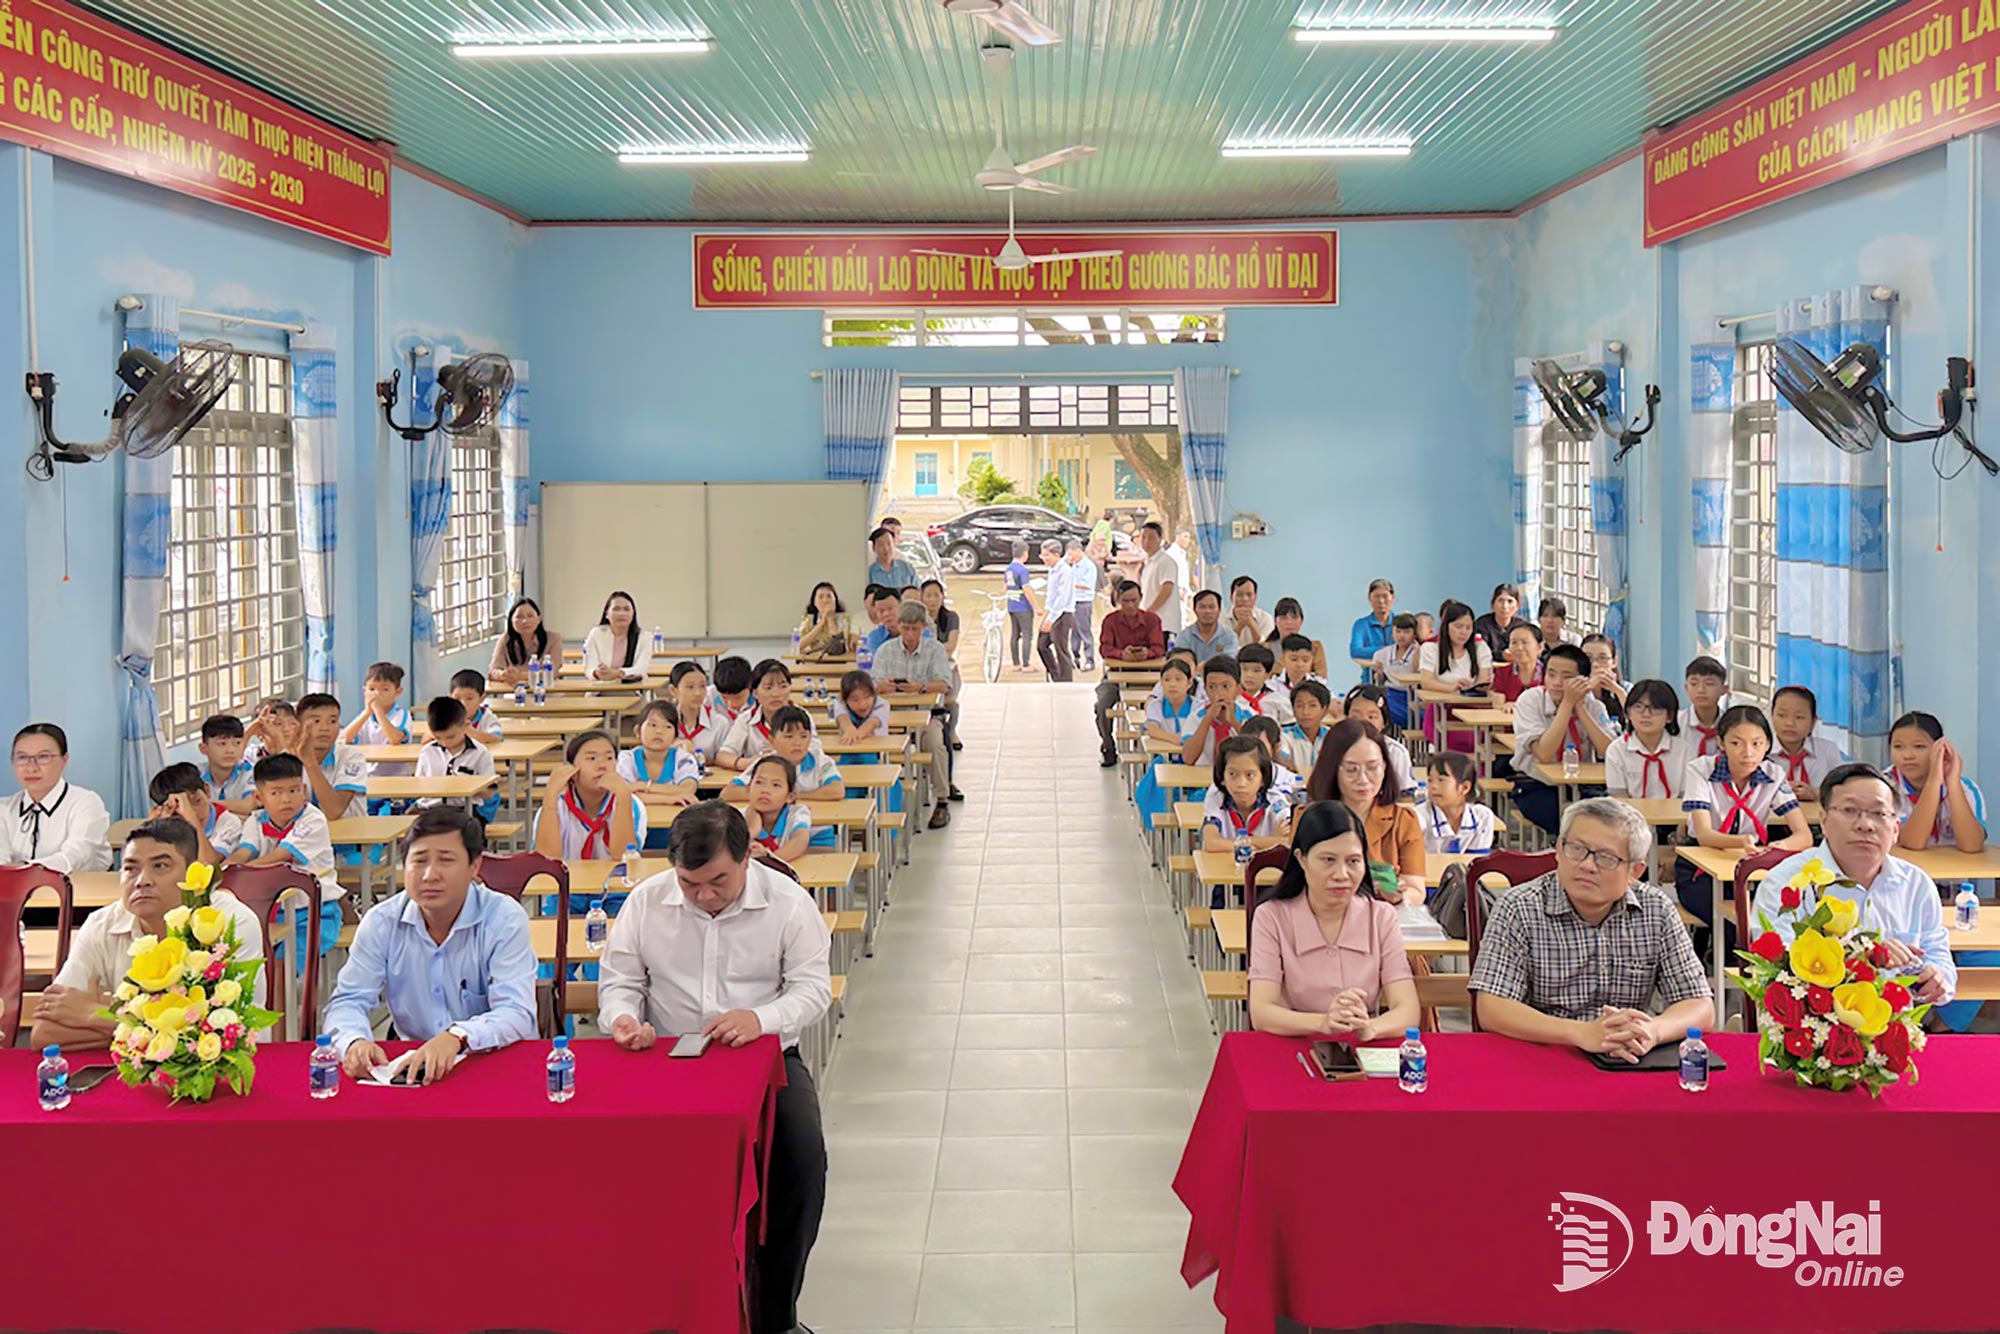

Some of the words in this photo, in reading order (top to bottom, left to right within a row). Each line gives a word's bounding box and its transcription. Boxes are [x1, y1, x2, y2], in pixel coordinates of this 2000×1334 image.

[13, 76, 63, 123] CÁC
[70, 93, 116, 146] CẤP,
[123, 122, 185, 166] NHIỆM
[191, 138, 212, 174] KỲ
[217, 150, 256, 188] 2025
[270, 170, 304, 205] 2030
[41, 29, 104, 84] CÔNG
[109, 62, 150, 99] TRỨ
[154, 83, 210, 124] QUYẾT
[214, 99, 249, 140] TÂM
[253, 117, 289, 158] THỰC
[293, 135, 324, 172] HIỆN
[327, 147, 365, 188] THẮNG
[367, 167, 385, 198] LỢI
[1654, 147, 1688, 184] ĐẢNG
[1692, 131, 1728, 168] CỘNG
[1733, 105, 1765, 147] SẢN
[1770, 86, 1805, 130] VIỆT
[1811, 61, 1856, 112] NAM
[1878, 12, 1952, 81] NGƯỜI
[1758, 140, 1793, 183] CỦA
[1797, 125, 1848, 168] CÁCH
[1854, 89, 1922, 144] MẠNG
[1930, 61, 1987, 118] VIỆT
[712, 243, 767, 296] SỐNG,
[773, 245, 826, 292] CHIẾN
[832, 243, 874, 295] ĐẤU,
[879, 255, 911, 291] LAO
[916, 247, 966, 299] ĐỘNG
[970, 247, 994, 291] VÀ
[1000, 264, 1035, 298] HỌC
[1042, 248, 1073, 298] TẬP
[1078, 254, 1123, 290] THEO
[1128, 250, 1189, 290] GƯƠNG
[1195, 246, 1230, 289] BÁC
[1236, 241, 1260, 289] HỒ
[1265, 246, 1283, 289] VĨ
[1287, 253, 1318, 297] ĐẠI
